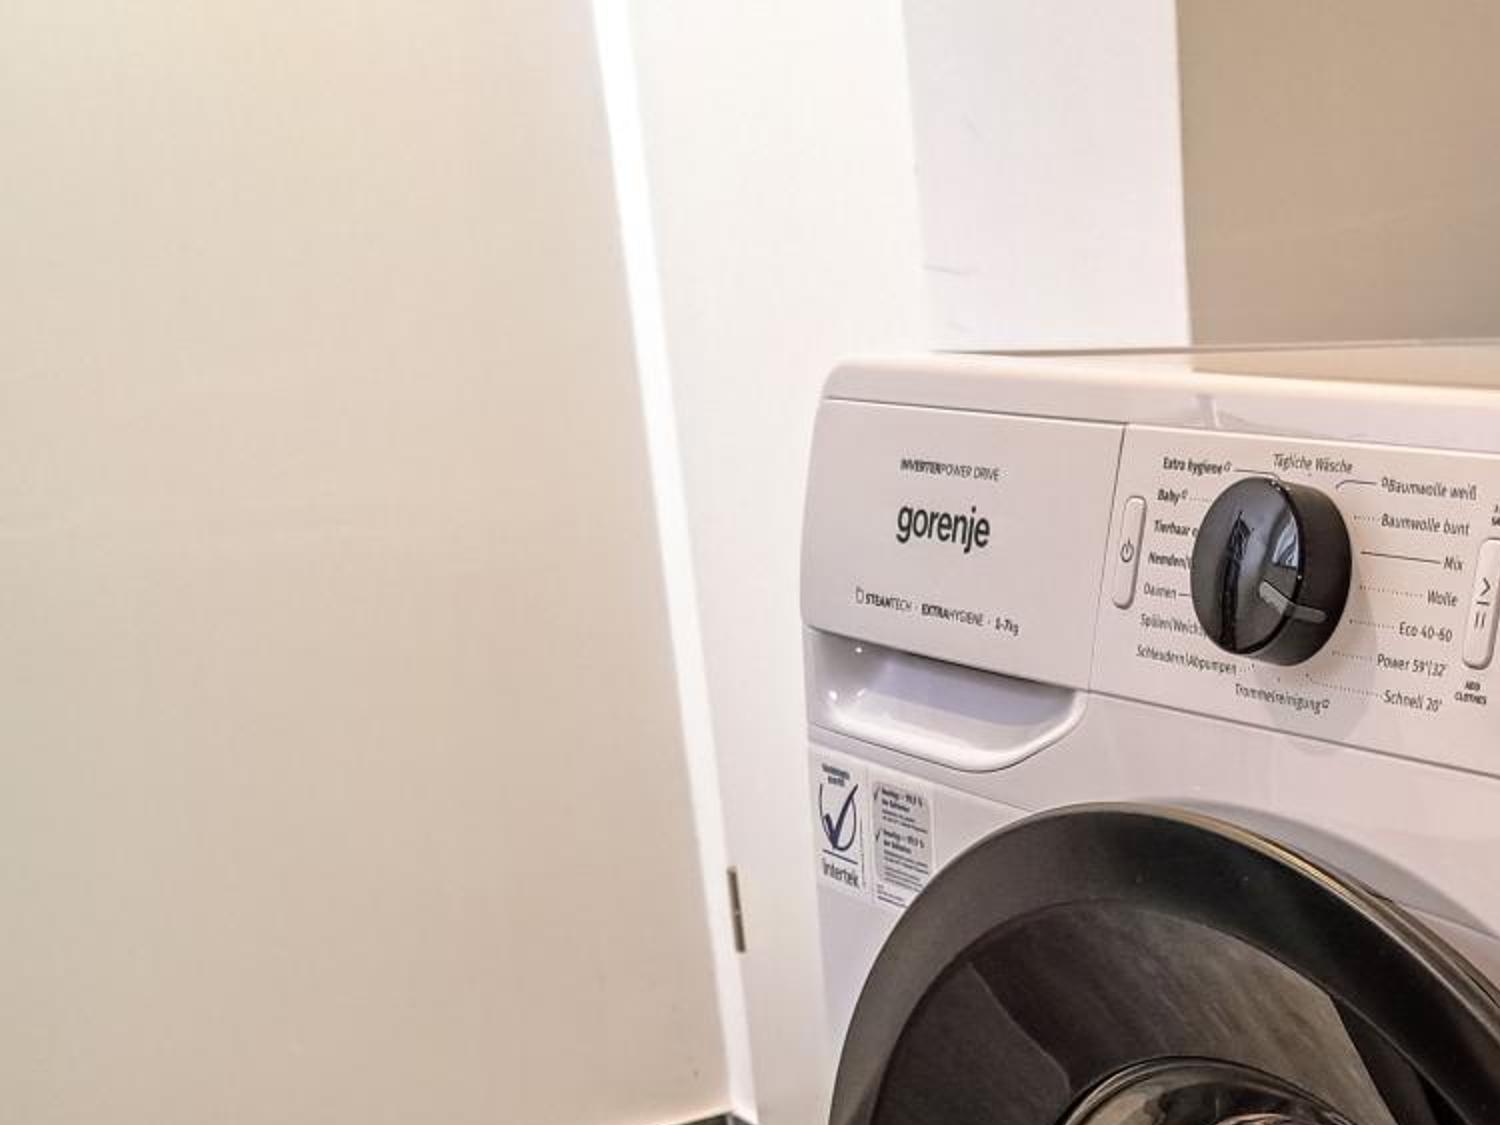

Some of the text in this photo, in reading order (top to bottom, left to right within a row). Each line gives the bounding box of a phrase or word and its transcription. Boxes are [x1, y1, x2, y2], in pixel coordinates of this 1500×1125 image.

[973, 466, 999, 482] DRIVE
[1163, 457, 1222, 477] Extra hygiene
[1315, 456, 1353, 474] Wäsche
[1157, 489, 1180, 506] Baby
[1387, 479, 1447, 498] Baumwolle
[896, 505, 990, 554] gorenje
[1381, 513, 1470, 536] Baumwolle bunt
[1443, 555, 1463, 571] Mix
[1427, 590, 1458, 607] Wolle
[1399, 621, 1453, 643] Eco 40-60
[1377, 653, 1410, 671] Power
[1384, 689, 1424, 709] Schnell
